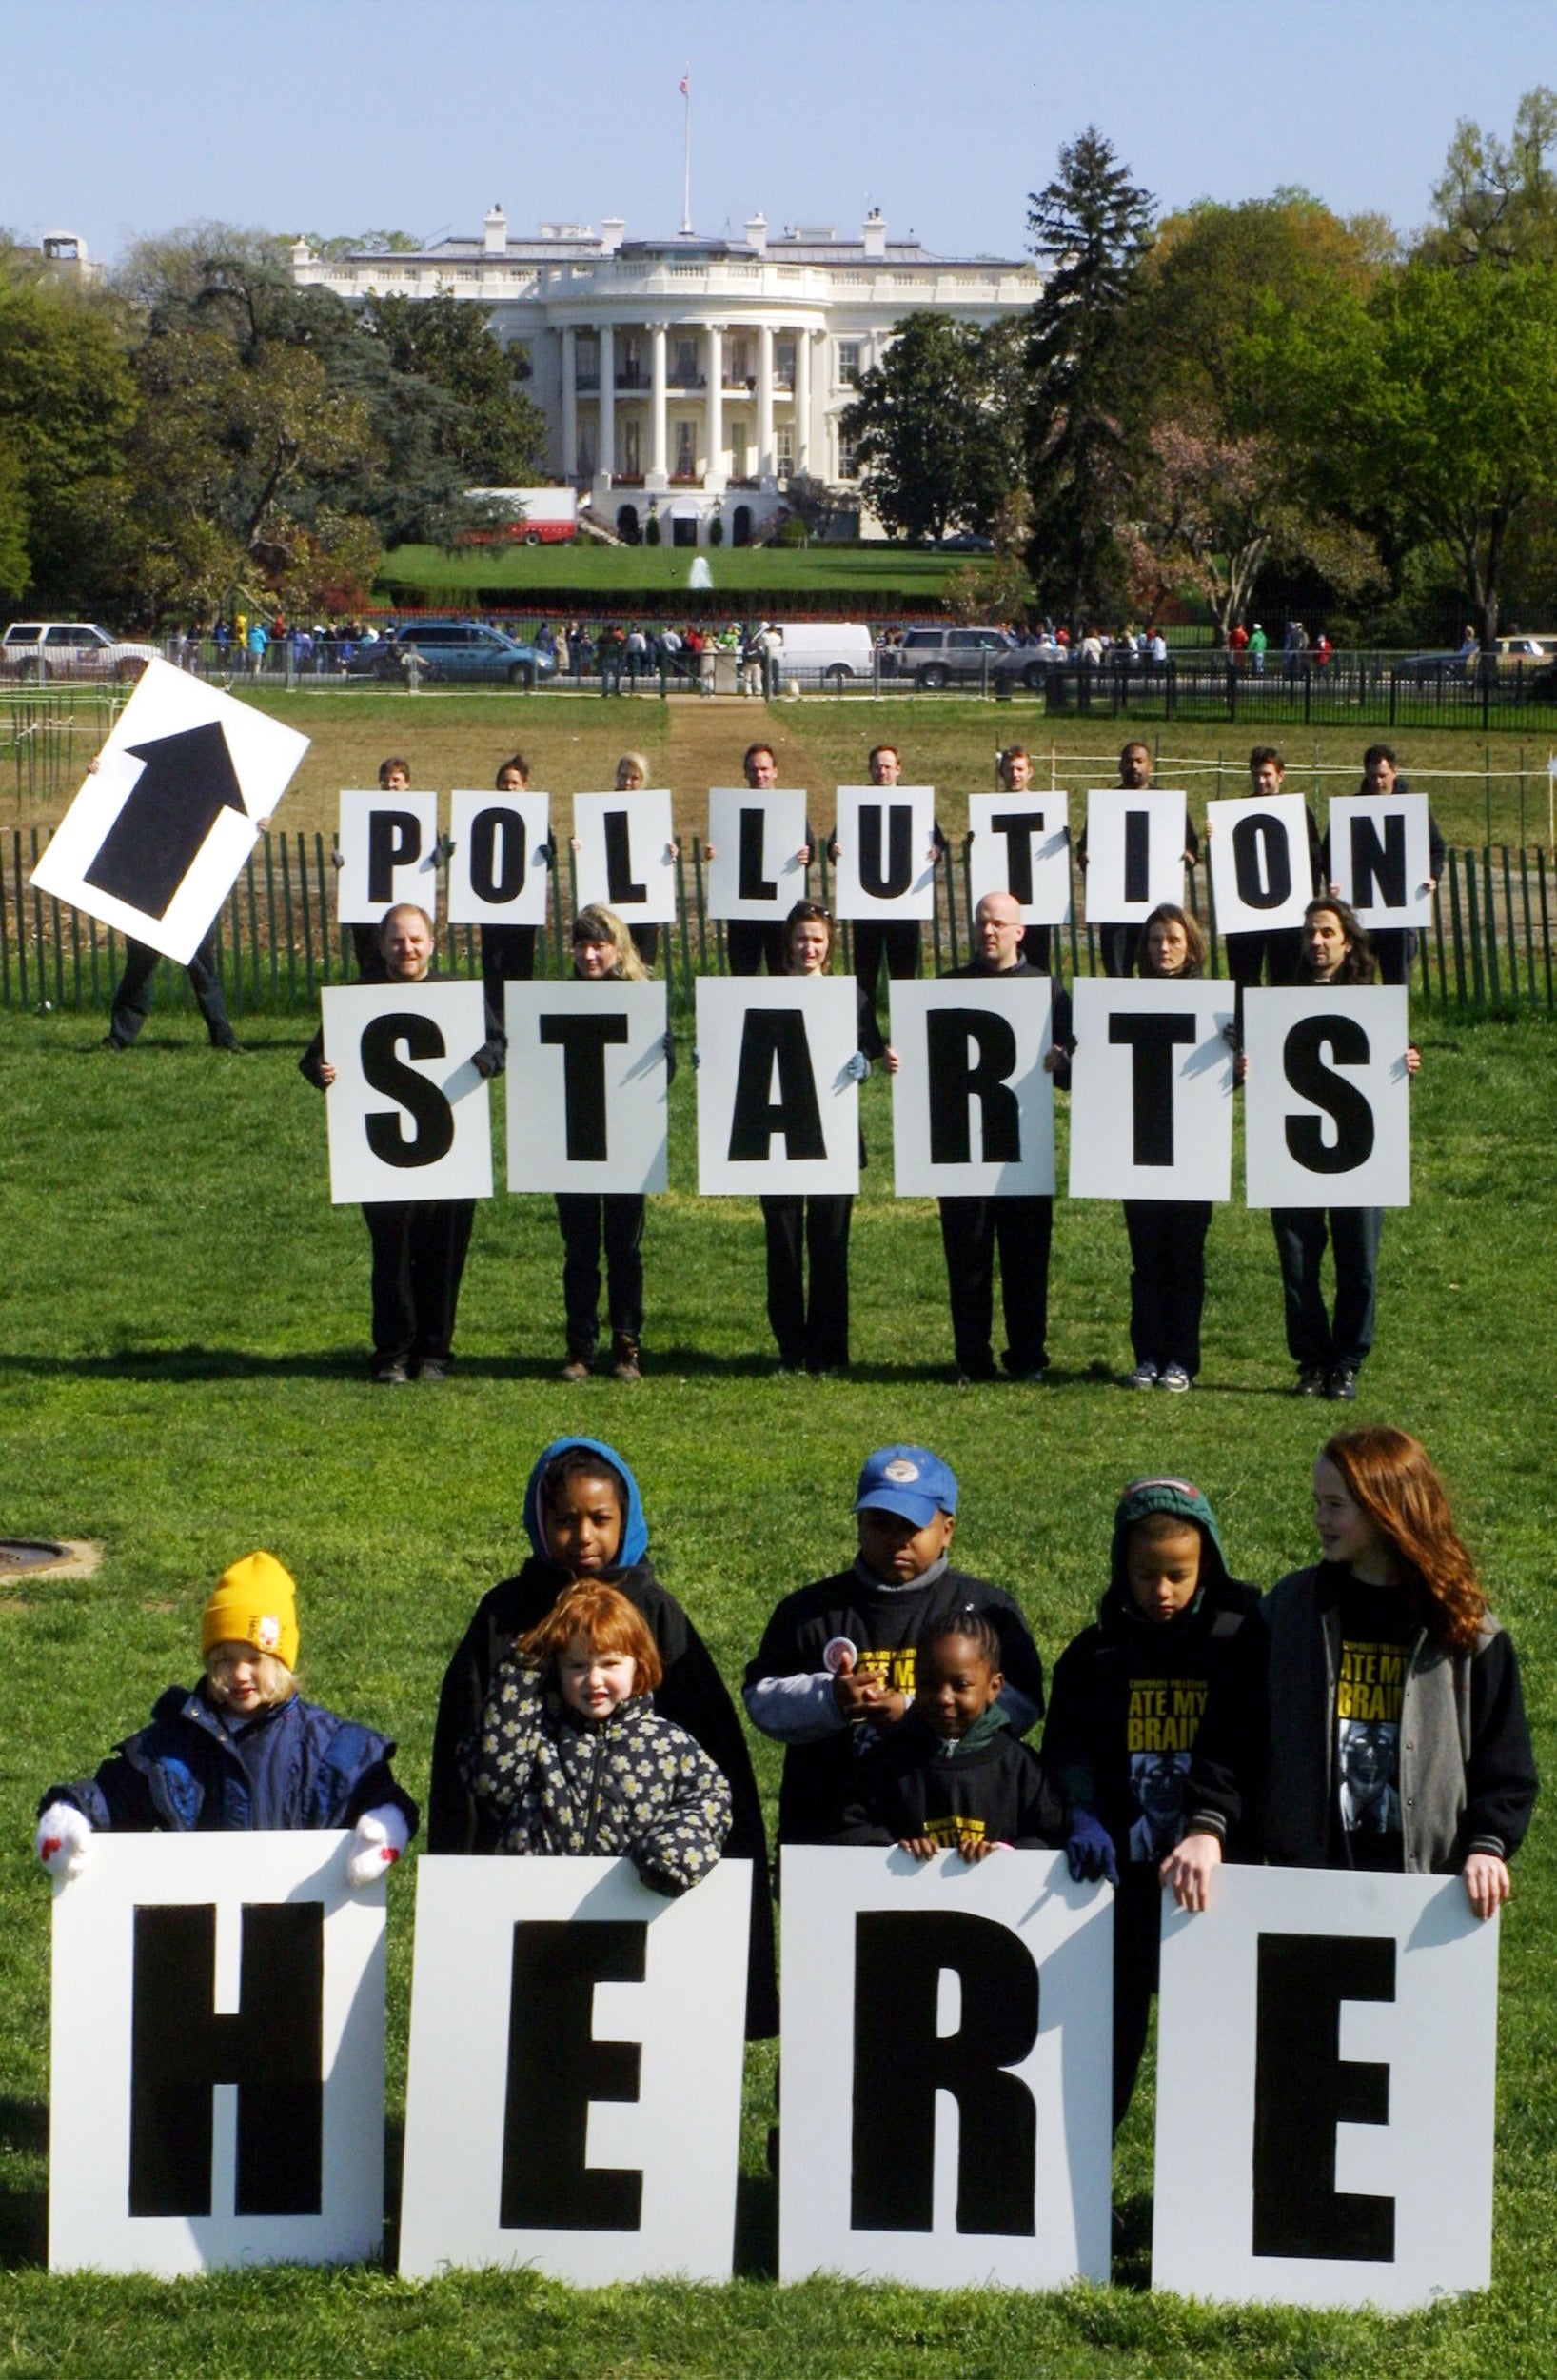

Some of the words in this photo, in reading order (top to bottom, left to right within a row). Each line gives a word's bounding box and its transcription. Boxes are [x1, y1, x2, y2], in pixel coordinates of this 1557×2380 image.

[1339, 1652, 1376, 1683] ATE
[1129, 1690, 1168, 1716] ATE
[1173, 1690, 1209, 1716] MY
